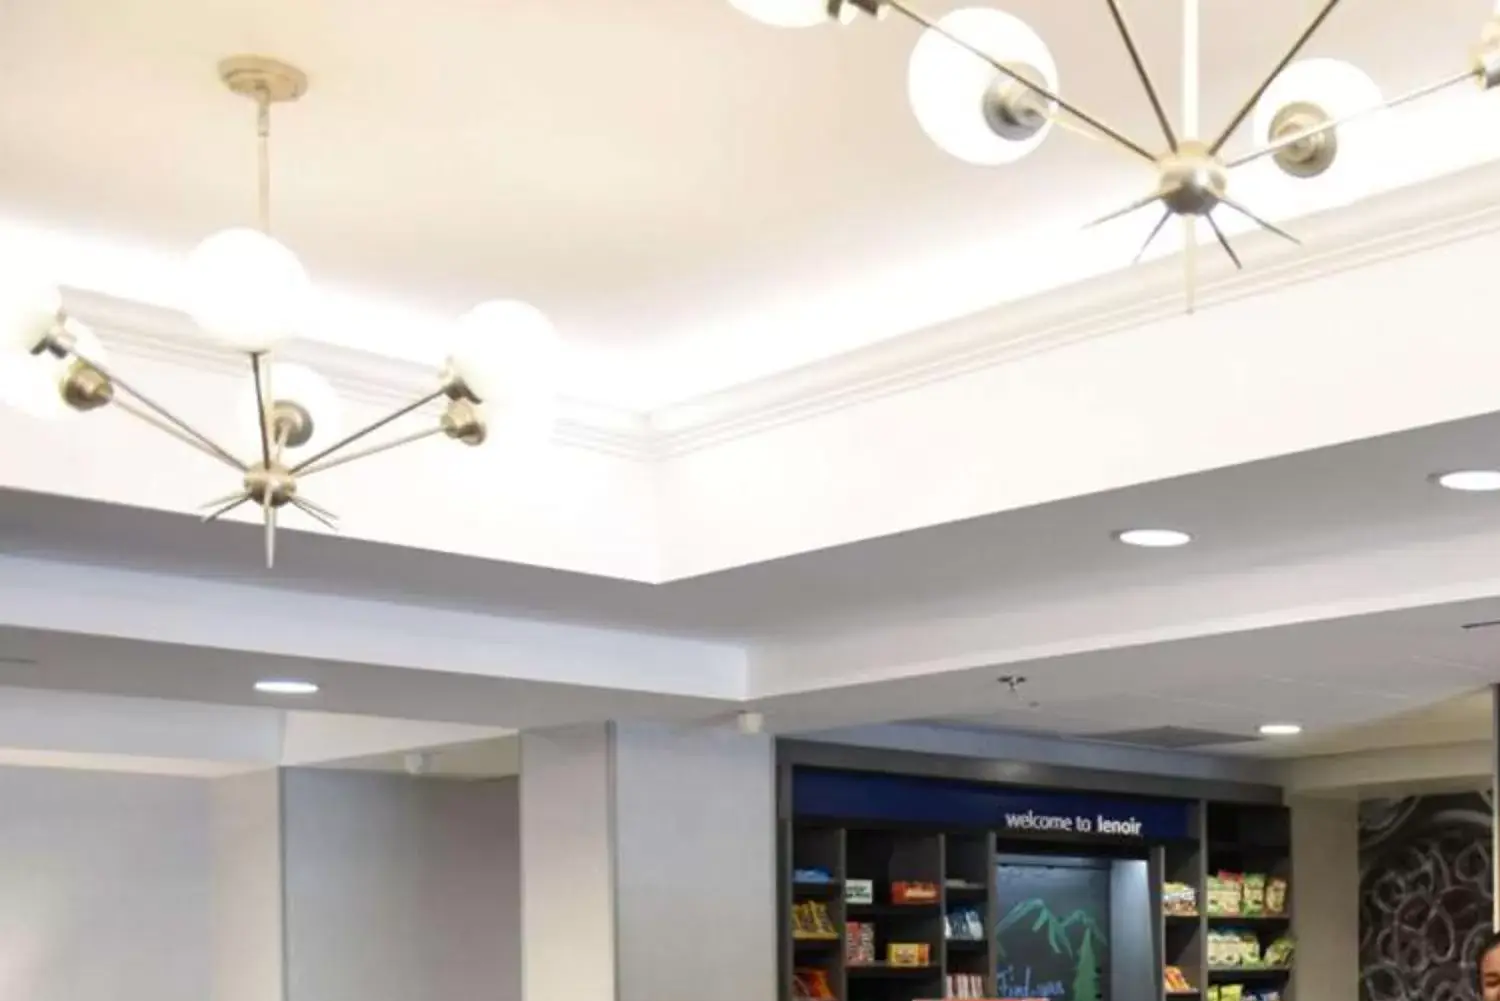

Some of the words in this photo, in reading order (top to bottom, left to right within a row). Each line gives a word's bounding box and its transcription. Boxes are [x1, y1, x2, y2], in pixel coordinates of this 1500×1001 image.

[1004, 809, 1073, 832] welcome
[1075, 815, 1092, 833] to
[1097, 814, 1142, 837] lenoir
